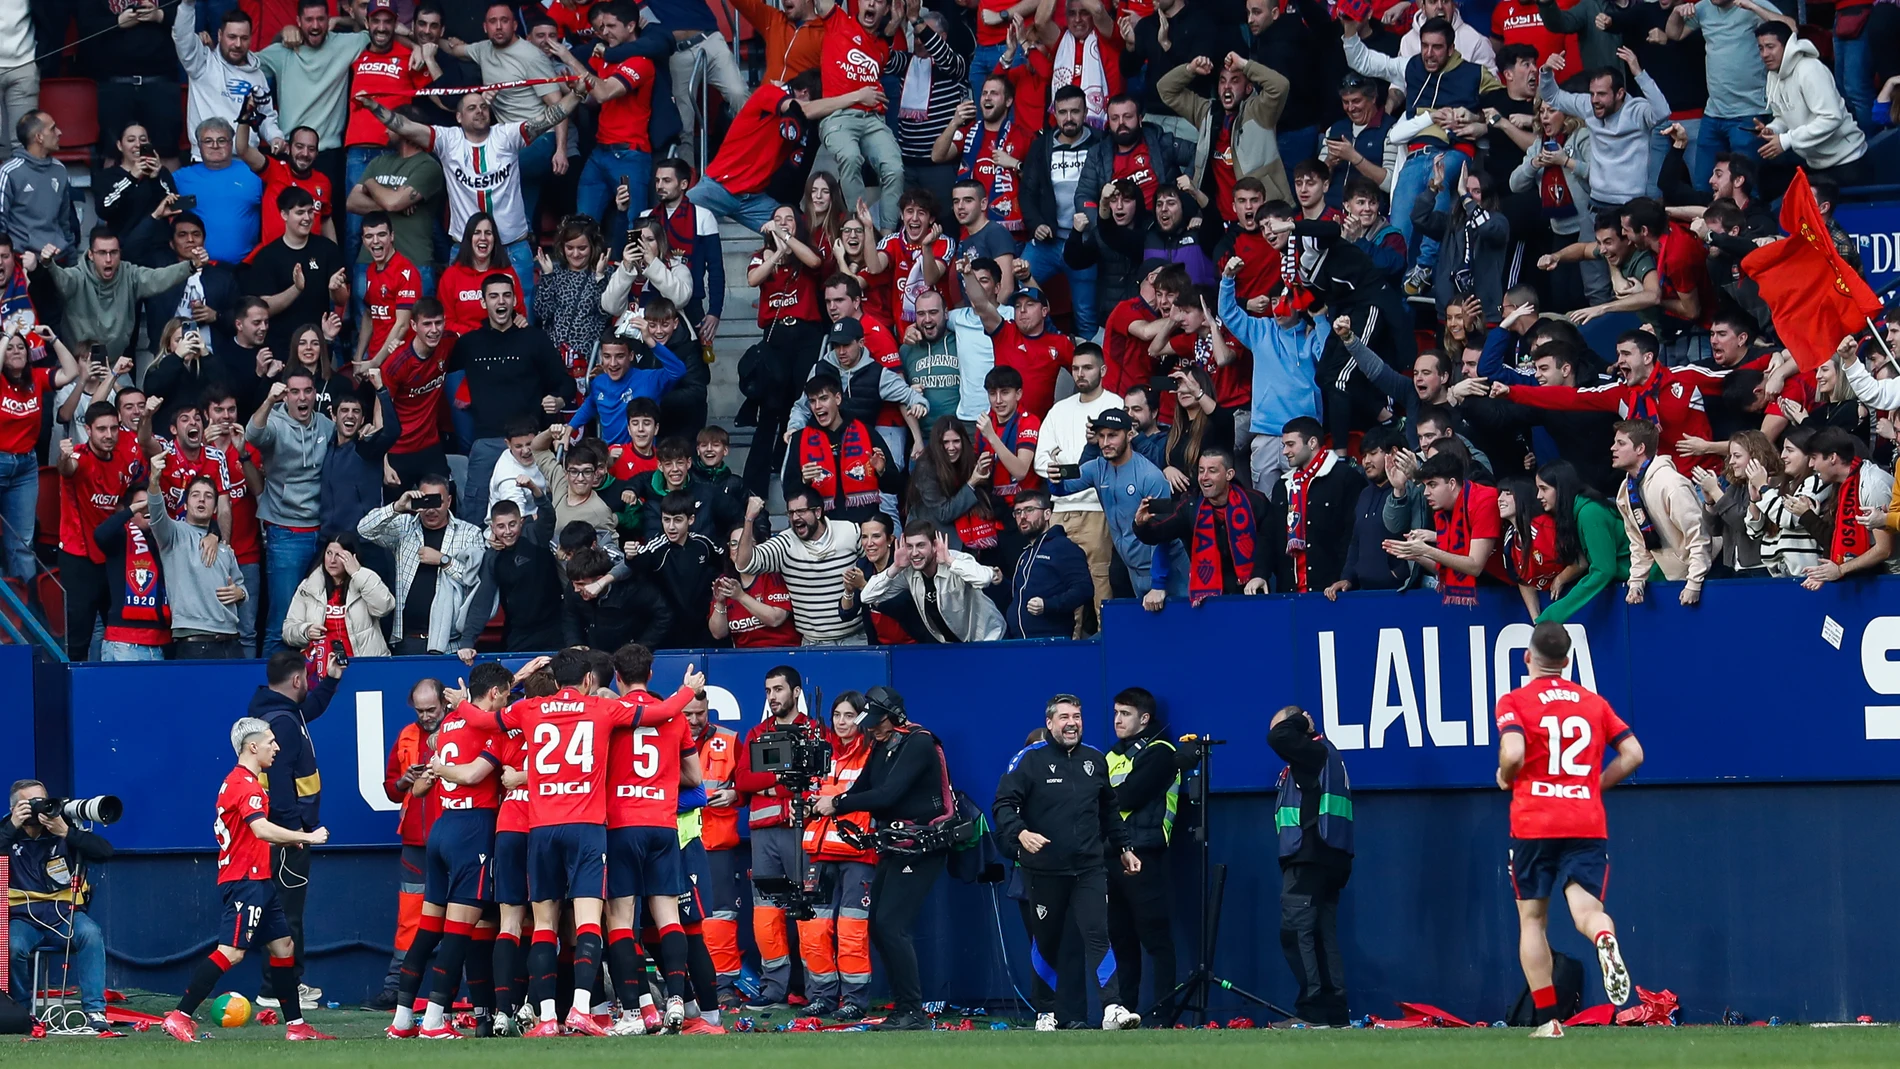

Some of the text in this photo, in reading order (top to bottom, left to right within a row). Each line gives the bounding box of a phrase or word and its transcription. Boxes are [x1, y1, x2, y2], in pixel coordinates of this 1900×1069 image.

[126, 595, 156, 606] 1920
[1538, 688, 1580, 704] ARESO
[540, 701, 585, 714] CATENA
[533, 721, 595, 775] 24
[632, 726, 659, 779] 5
[1539, 715, 1592, 777] 12
[539, 782, 591, 796] DIGI
[616, 784, 665, 801] DIGI
[1531, 781, 1591, 800] DIGI
[247, 905, 262, 928] 19
